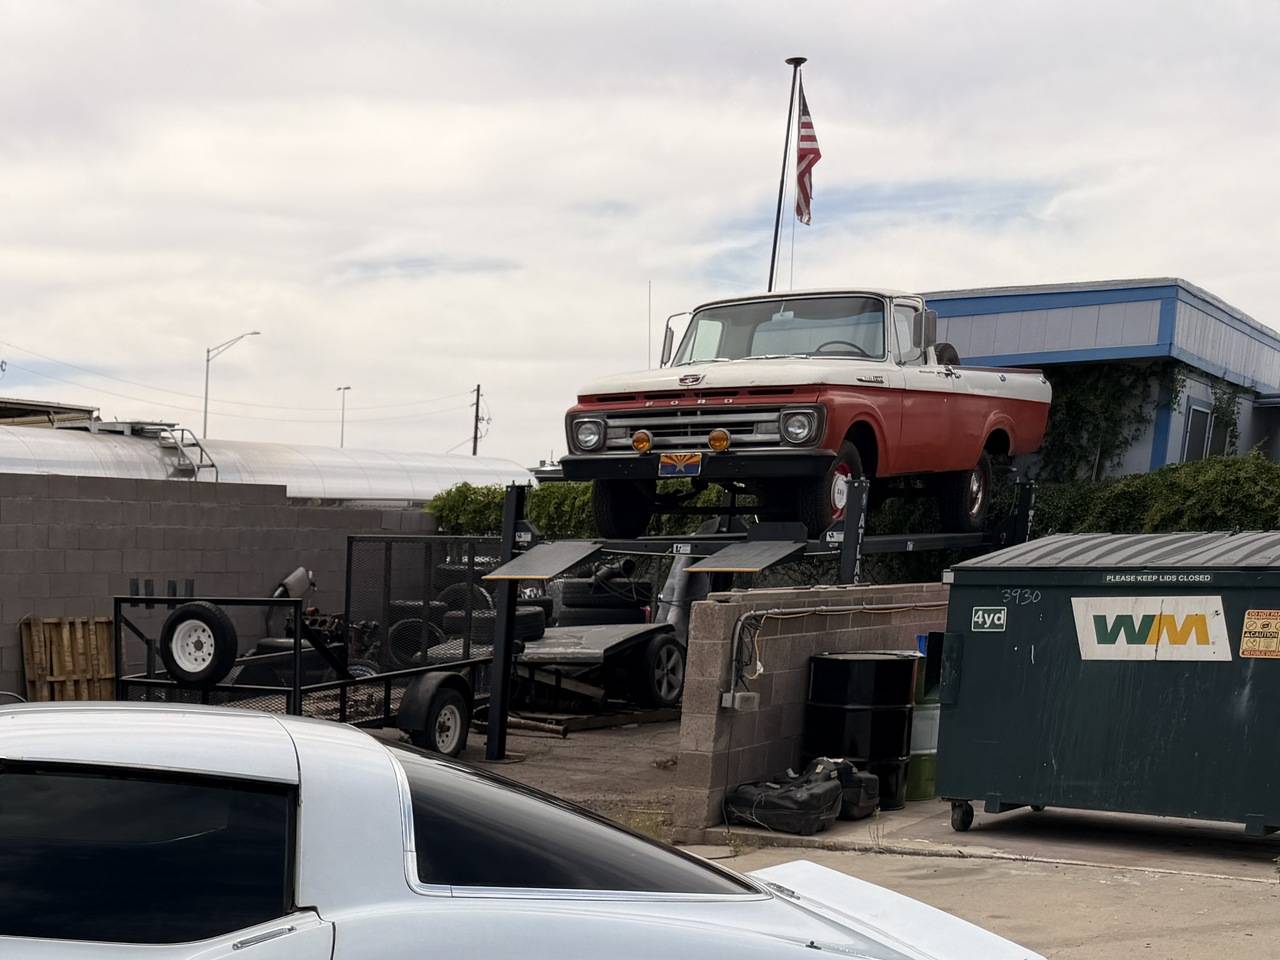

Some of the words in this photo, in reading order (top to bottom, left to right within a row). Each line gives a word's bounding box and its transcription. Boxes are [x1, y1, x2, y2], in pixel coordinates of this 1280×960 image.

[644, 399, 734, 407] FORD
[1001, 588, 1042, 605] 3930
[973, 610, 1005, 628] 4yd
[1092, 614, 1210, 645] WM
